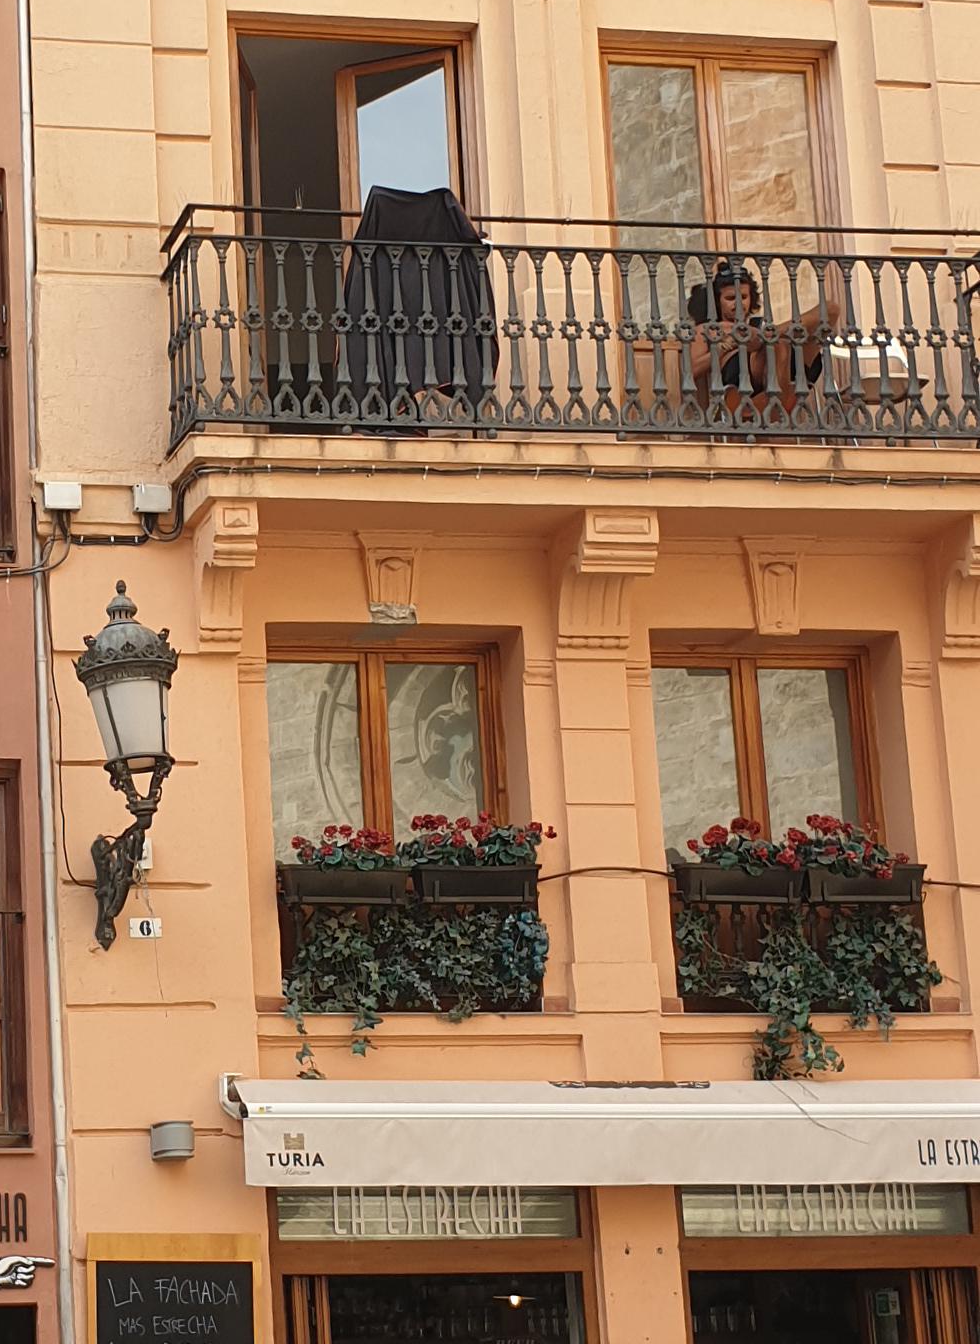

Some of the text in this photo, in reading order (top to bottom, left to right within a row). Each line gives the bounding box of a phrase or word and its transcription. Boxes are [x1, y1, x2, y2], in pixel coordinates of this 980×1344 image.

[139, 920, 152, 936] 6
[266, 1152, 325, 1167] TURIA
[918, 1139, 937, 1166] LA
[108, 1276, 239, 1306] LA FACHADA
[119, 1315, 218, 1336] MAS ESTRECHA
